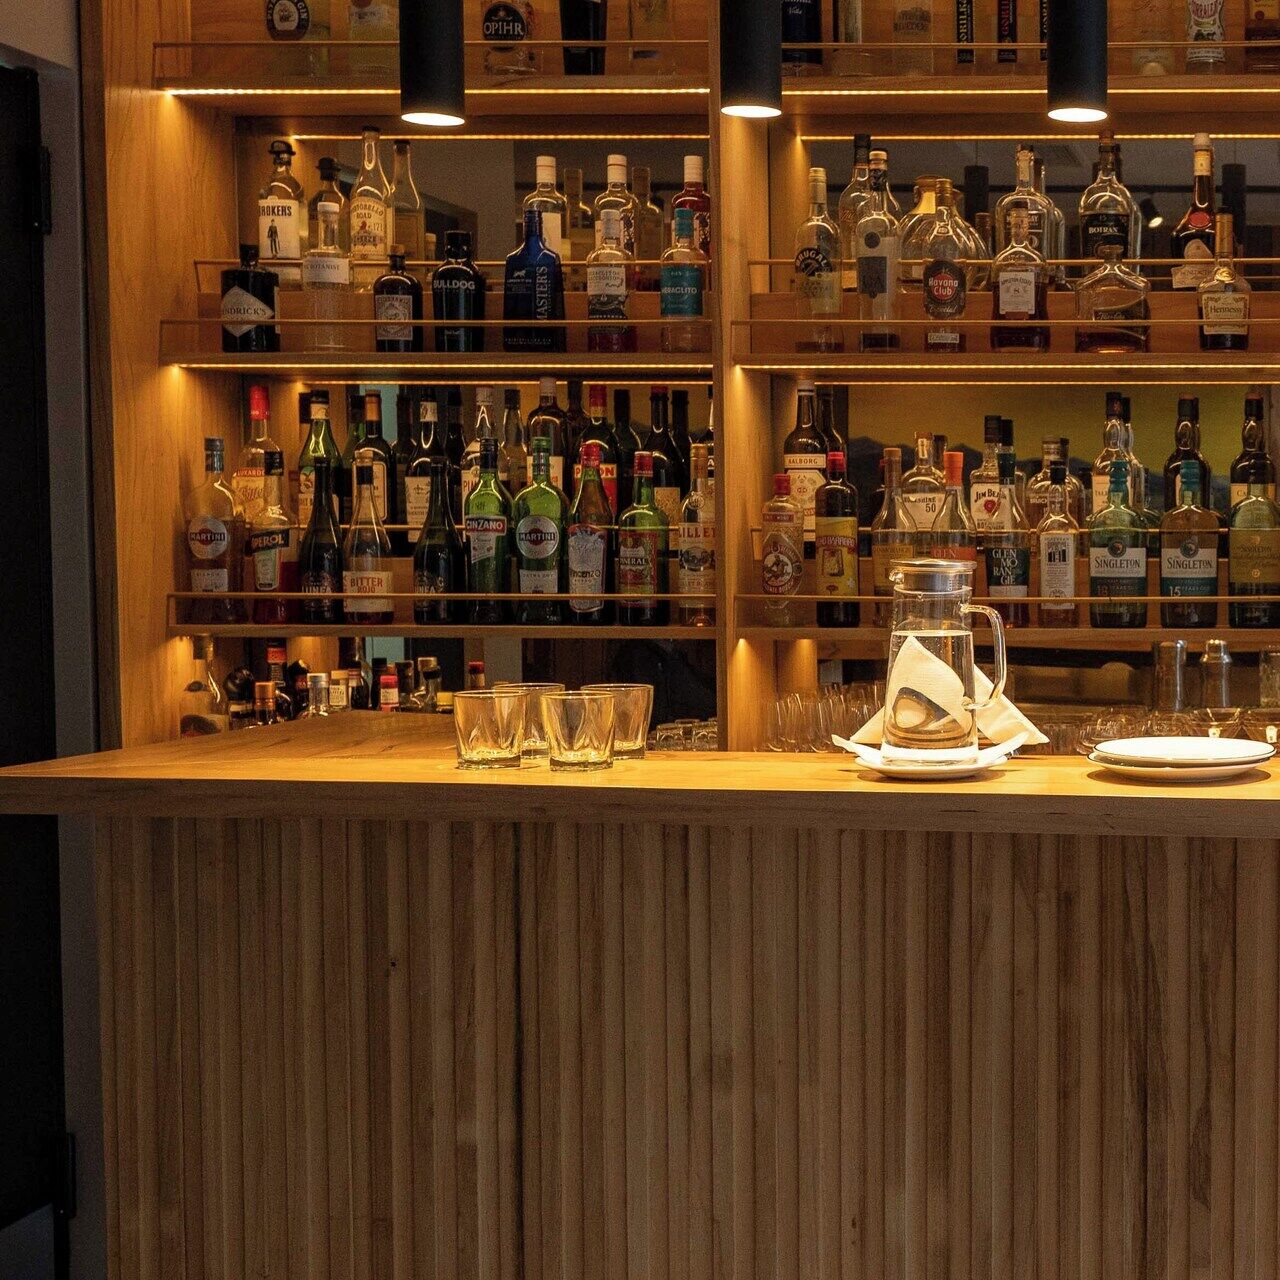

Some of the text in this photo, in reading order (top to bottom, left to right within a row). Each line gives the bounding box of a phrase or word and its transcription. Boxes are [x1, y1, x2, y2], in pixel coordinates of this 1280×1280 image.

[483, 22, 525, 35] OPIHR
[433, 279, 475, 290] BULLDOG
[928, 278, 959, 288] Havana
[535, 266, 548, 319] ASTER'S
[933, 286, 953, 296] Club
[223, 306, 267, 317] NDRICK'S
[1209, 305, 1243, 316] Hennessy
[788, 458, 818, 466] AALBORG
[974, 490, 986, 503] JIM
[925, 503, 936, 513] 50
[466, 518, 504, 531] CINZANO
[190, 532, 225, 542] MARTINI
[519, 532, 555, 542] MARTINI
[992, 549, 1017, 559] GLEN
[1001, 558, 1019, 568] MO
[1094, 557, 1141, 569] SINGLETON
[1167, 557, 1213, 569] SINGLETON
[992, 567, 1011, 577] RAN
[350, 577, 384, 588] BITTER
[1000, 574, 1016, 585] GIE
[357, 586, 376, 594] ROJO
[1168, 585, 1181, 597] 15
